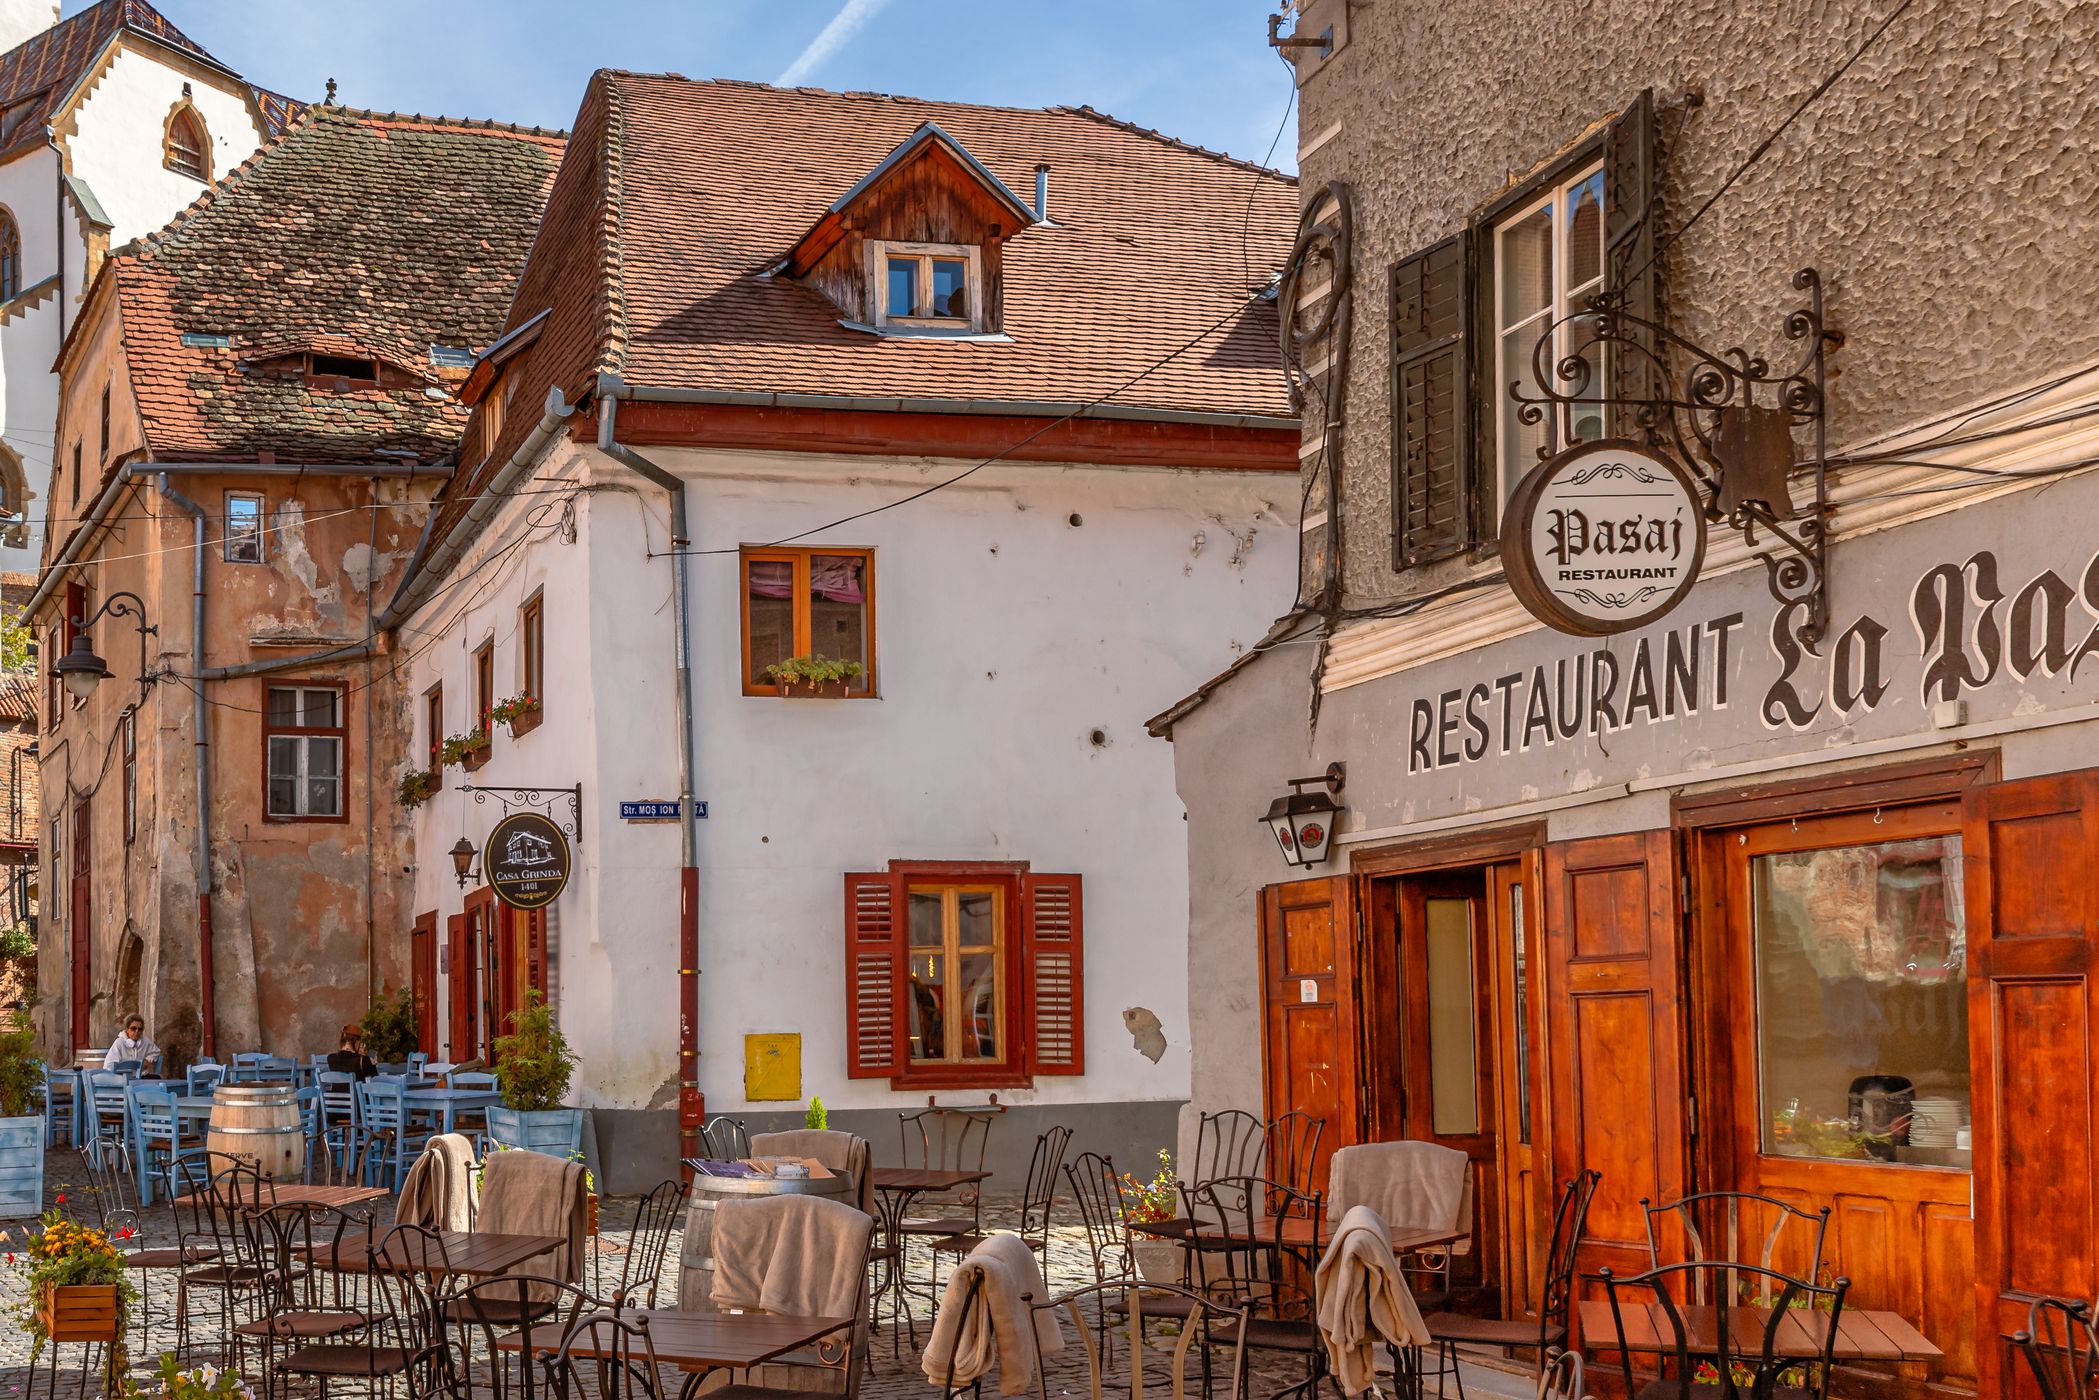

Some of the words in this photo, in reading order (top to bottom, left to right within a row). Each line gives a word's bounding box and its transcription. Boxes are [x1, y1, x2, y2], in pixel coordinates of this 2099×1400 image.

[1545, 506, 1683, 566] Pasaj
[1558, 567, 1678, 581] RESTAURANT
[1408, 611, 1743, 776] RESTAURANT
[1760, 595, 1891, 731] La
[623, 805, 637, 814] Str.
[659, 805, 674, 814] ION
[496, 871, 519, 880] CASA
[521, 870, 562, 879] GRINDA
[521, 882, 538, 891] 1401
